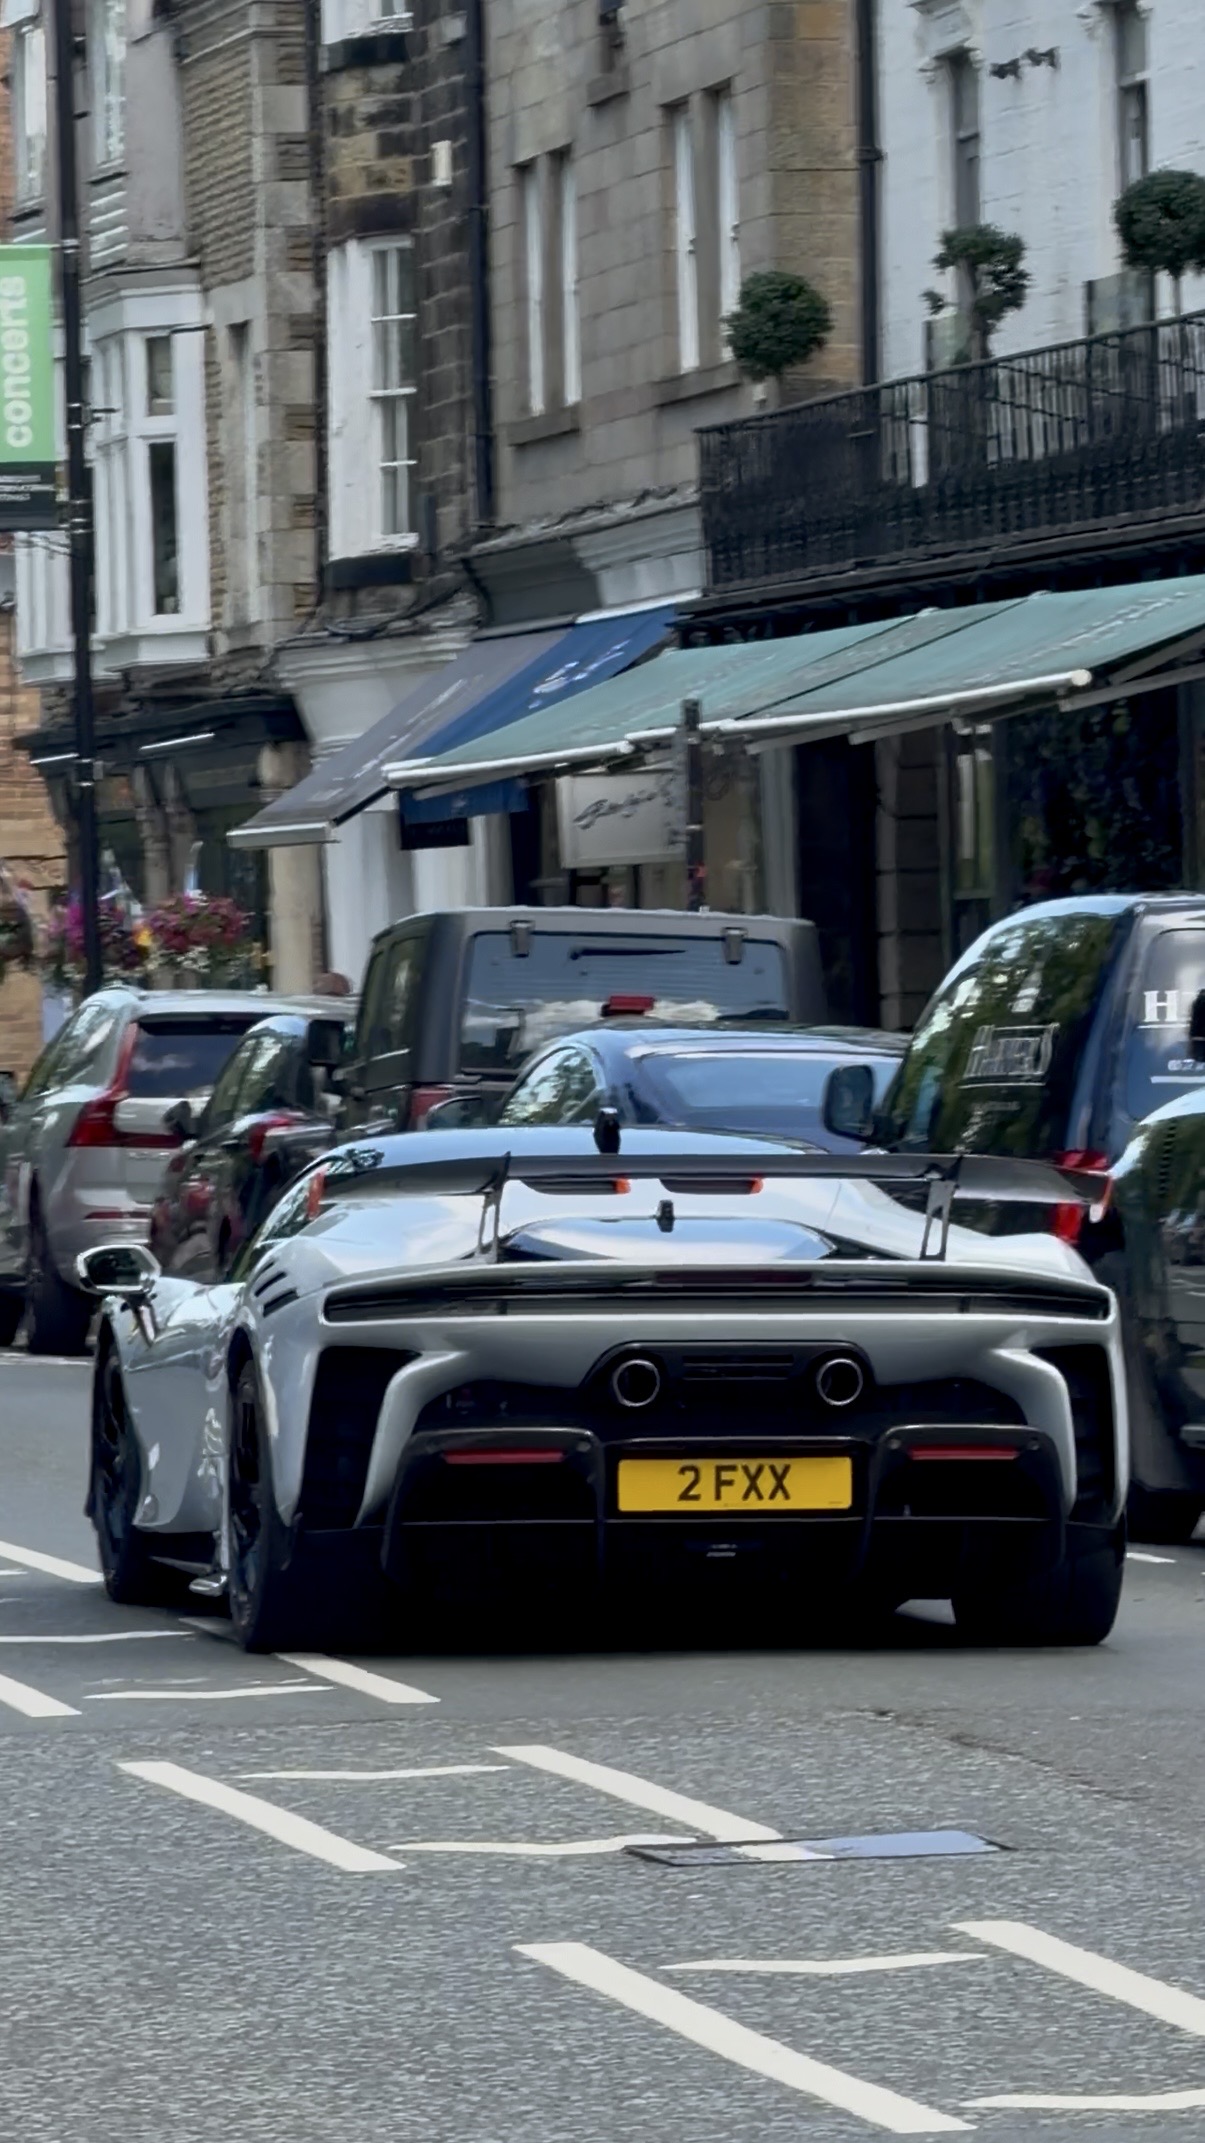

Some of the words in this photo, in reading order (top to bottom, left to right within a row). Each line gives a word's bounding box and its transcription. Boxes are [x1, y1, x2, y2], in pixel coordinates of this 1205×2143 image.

[0, 275, 33, 448] concerts
[678, 1464, 701, 1501] 2
[714, 1463, 791, 1501] FXX
